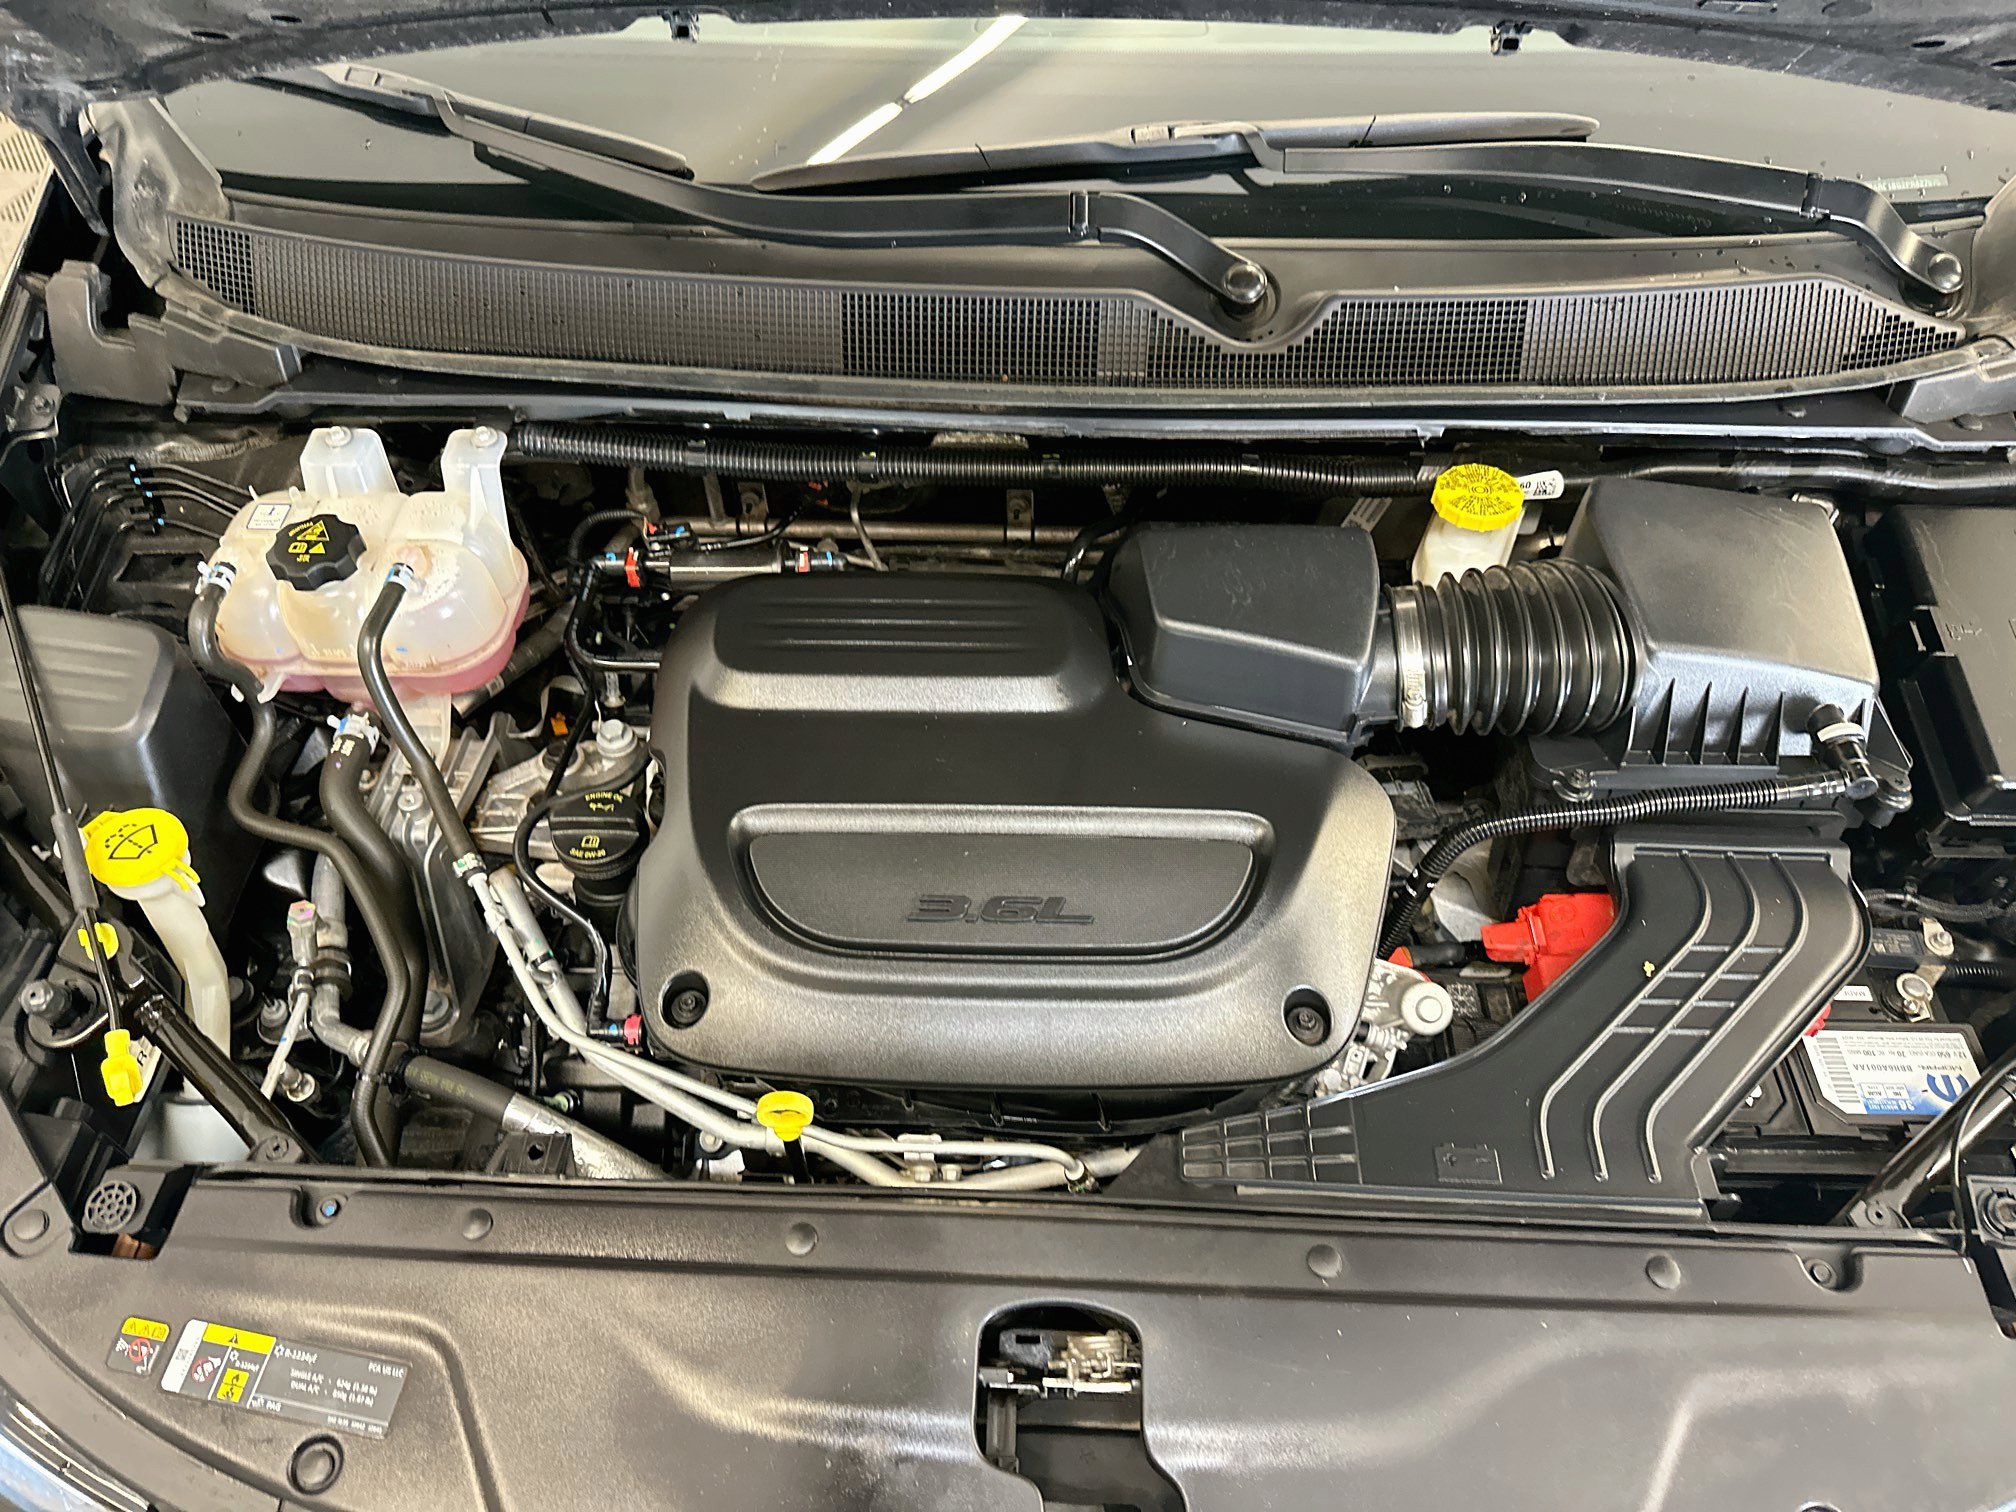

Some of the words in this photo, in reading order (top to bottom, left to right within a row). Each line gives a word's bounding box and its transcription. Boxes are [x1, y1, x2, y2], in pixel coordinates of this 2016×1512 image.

[585, 791, 612, 801] ENGINE
[570, 847, 583, 858] SAE
[907, 894, 1095, 924] 3.6L
